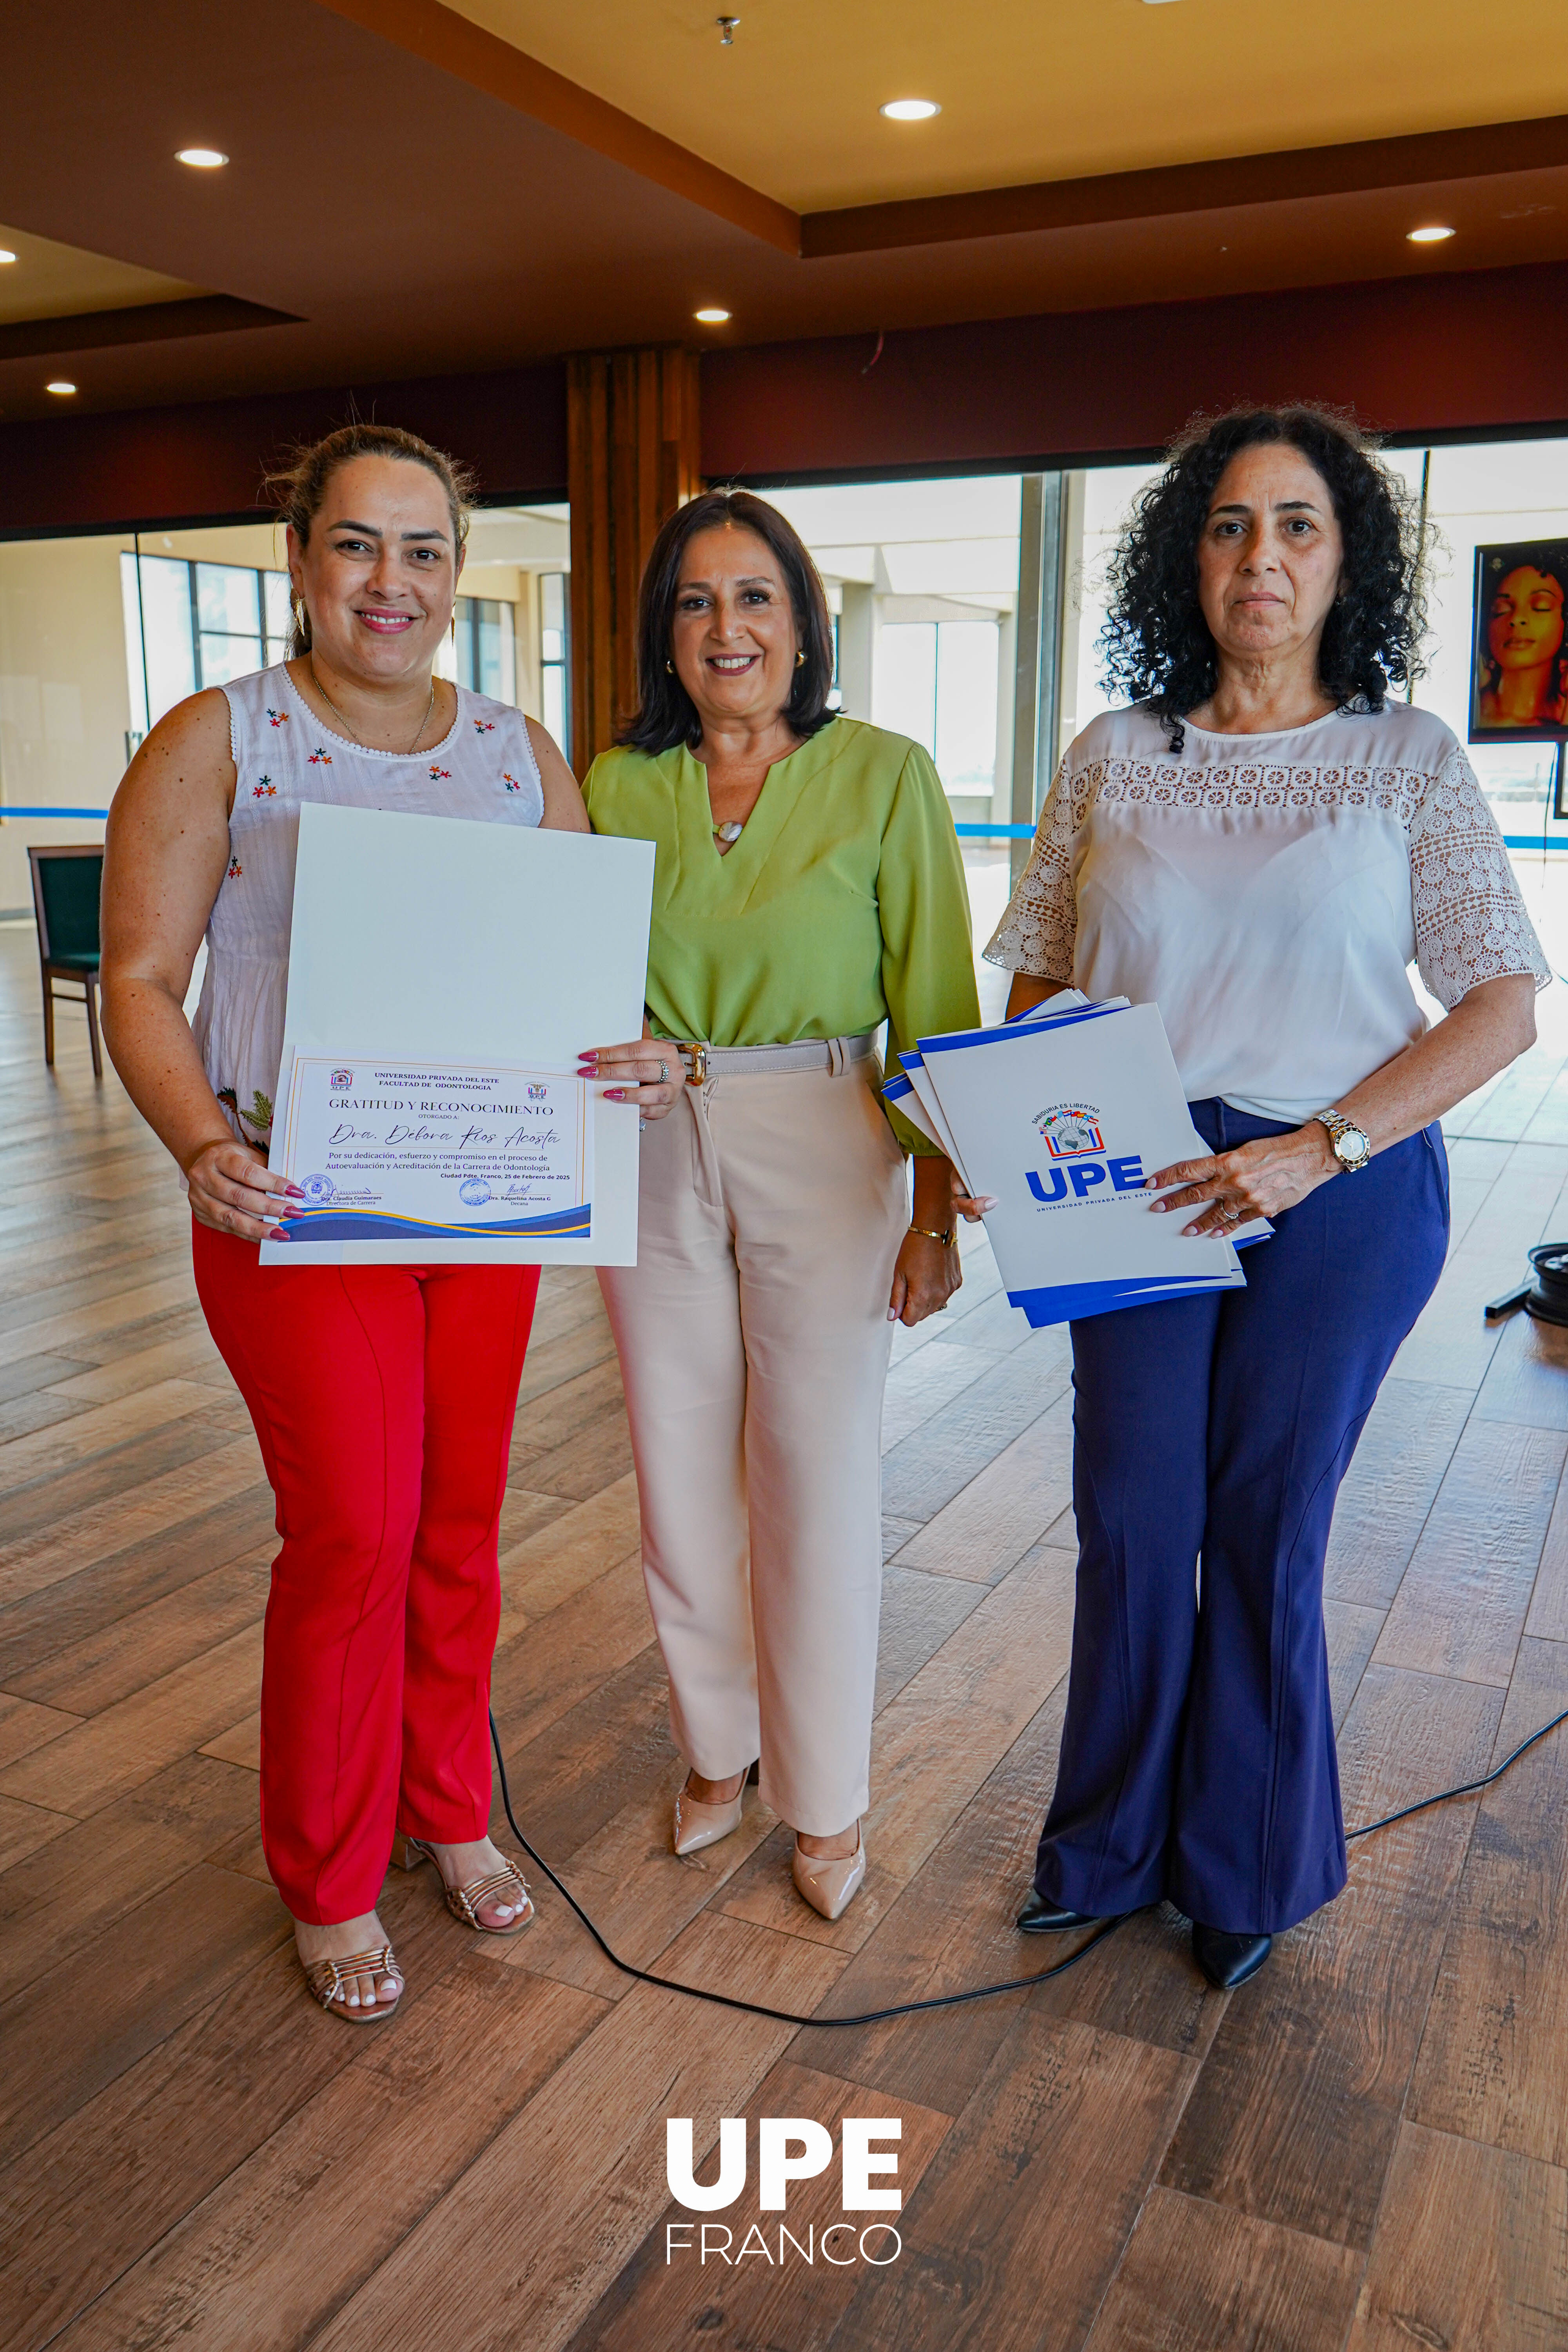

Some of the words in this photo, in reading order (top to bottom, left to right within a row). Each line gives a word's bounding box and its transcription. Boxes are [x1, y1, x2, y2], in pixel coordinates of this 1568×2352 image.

[329, 1099, 403, 1110] GRATITUD
[408, 1102, 417, 1110] Y
[421, 1102, 554, 1115] RECONOCIMIENTO
[1032, 1105, 1059, 1124] SABIDURIA
[1070, 1103, 1100, 1114] LIBERTAD
[329, 1124, 377, 1144] Dra.
[505, 1127, 561, 1149] Acosta
[1025, 1155, 1148, 1202] UPE
[1037, 1202, 1082, 1212] UNIVERSIDAD
